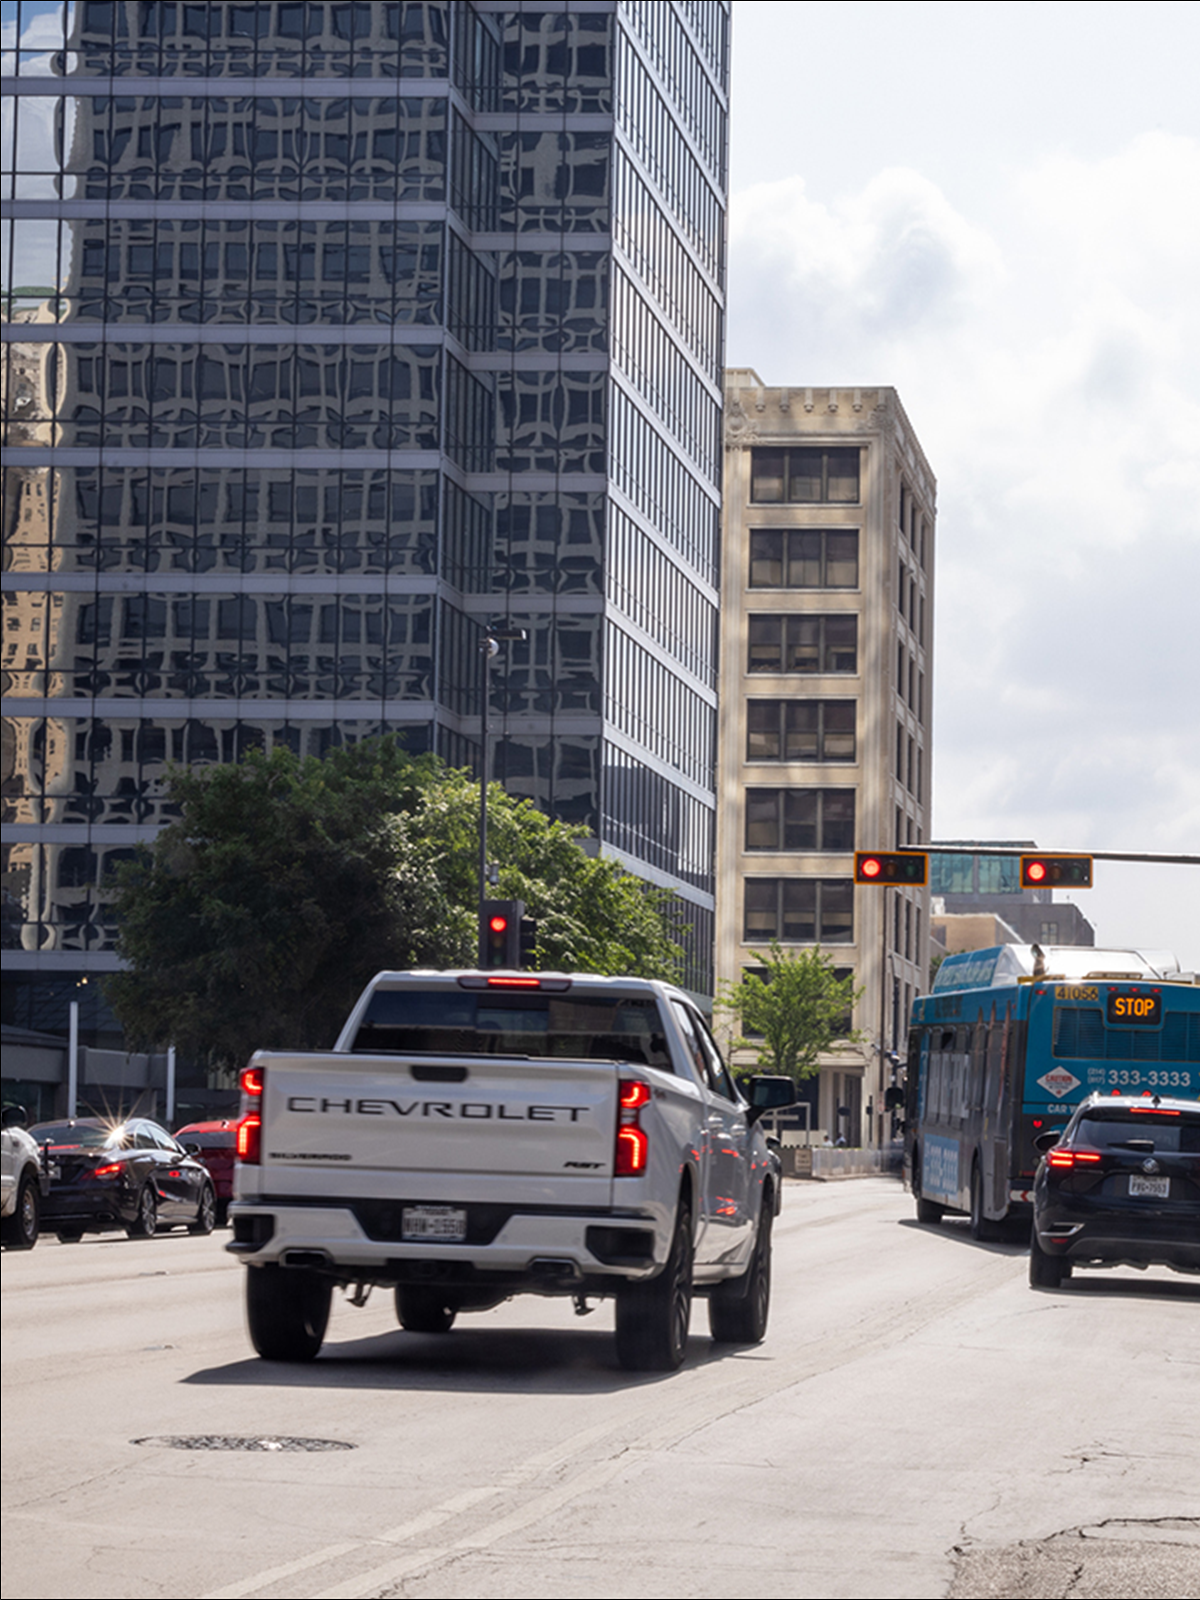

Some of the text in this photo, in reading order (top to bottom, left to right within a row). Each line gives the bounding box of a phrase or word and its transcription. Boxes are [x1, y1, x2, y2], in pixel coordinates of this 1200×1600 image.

[1056, 986, 1098, 1001] 41056
[1114, 996, 1156, 1017] STOP
[1108, 1069, 1191, 1088] 333-3333
[287, 1096, 590, 1123] CHEVROLET
[1047, 1103, 1068, 1114] CAR
